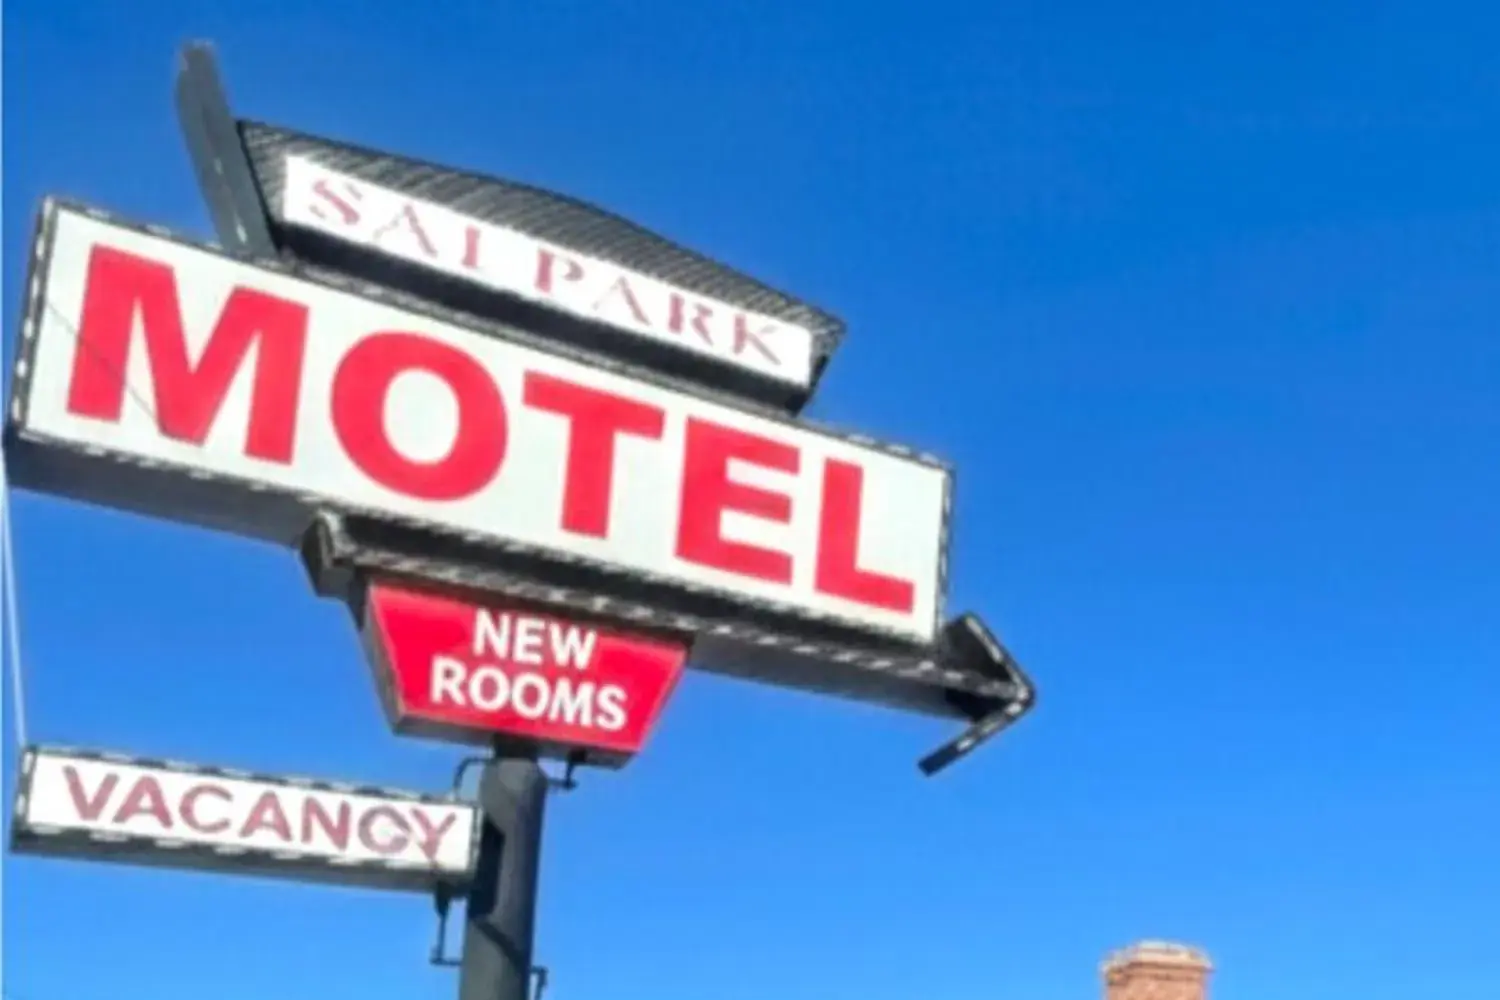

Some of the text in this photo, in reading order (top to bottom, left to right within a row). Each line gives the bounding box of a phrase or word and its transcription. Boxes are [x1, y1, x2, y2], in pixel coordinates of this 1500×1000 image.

[532, 249, 783, 367] PARK
[66, 246, 916, 614] MOTEL
[473, 608, 598, 670] NEW
[431, 655, 626, 731] ROOMS
[63, 764, 457, 859] VACANCY
